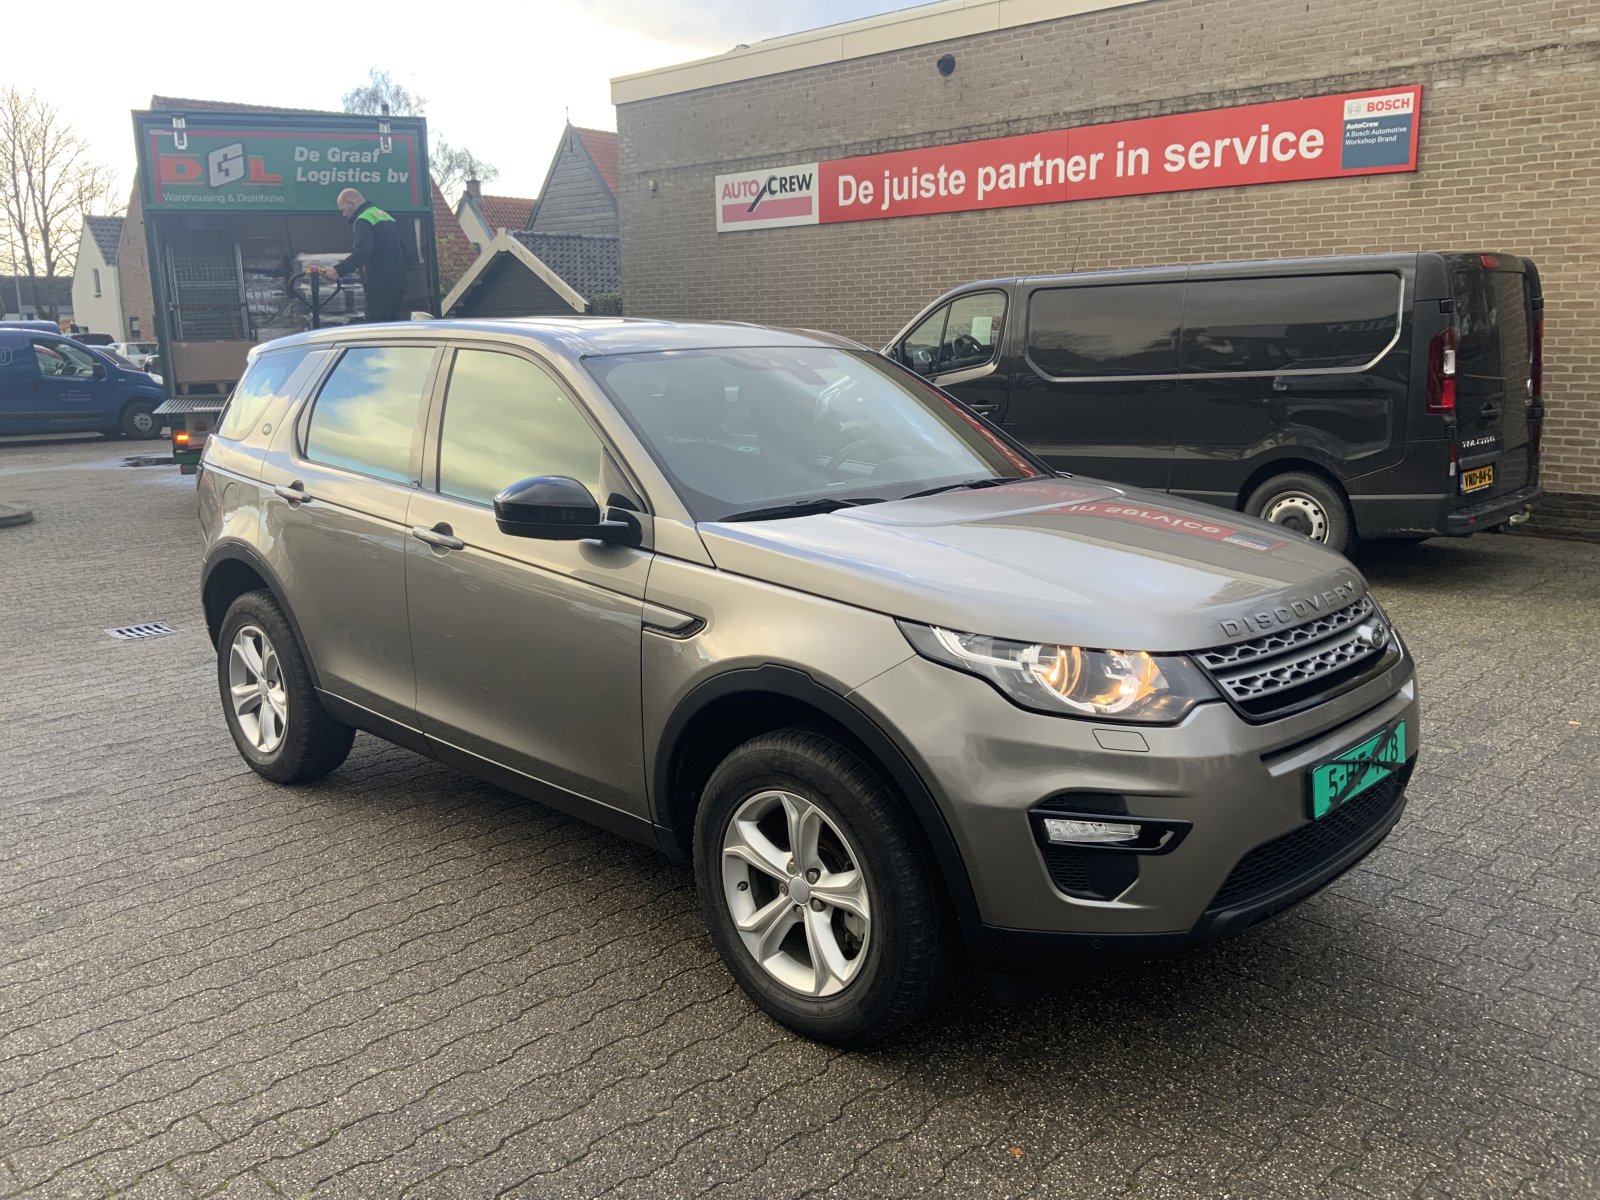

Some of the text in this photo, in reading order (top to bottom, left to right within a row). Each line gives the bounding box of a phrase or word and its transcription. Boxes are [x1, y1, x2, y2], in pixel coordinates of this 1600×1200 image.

[1366, 98, 1410, 113] BOSCH
[1346, 121, 1379, 130] AutoCrew
[1351, 129, 1370, 137] Bosch
[1371, 126, 1407, 135] Automotive
[1345, 137, 1376, 146] Workshop
[294, 146, 381, 163] De Graaf
[838, 124, 1325, 211] De juiste partner in service
[296, 167, 409, 185] Logistics bv
[722, 173, 813, 200] AUTO CREW
[163, 193, 225, 204] Warehousing
[237, 193, 284, 203] Distributie
[1220, 580, 1356, 637] DISCOVERY
